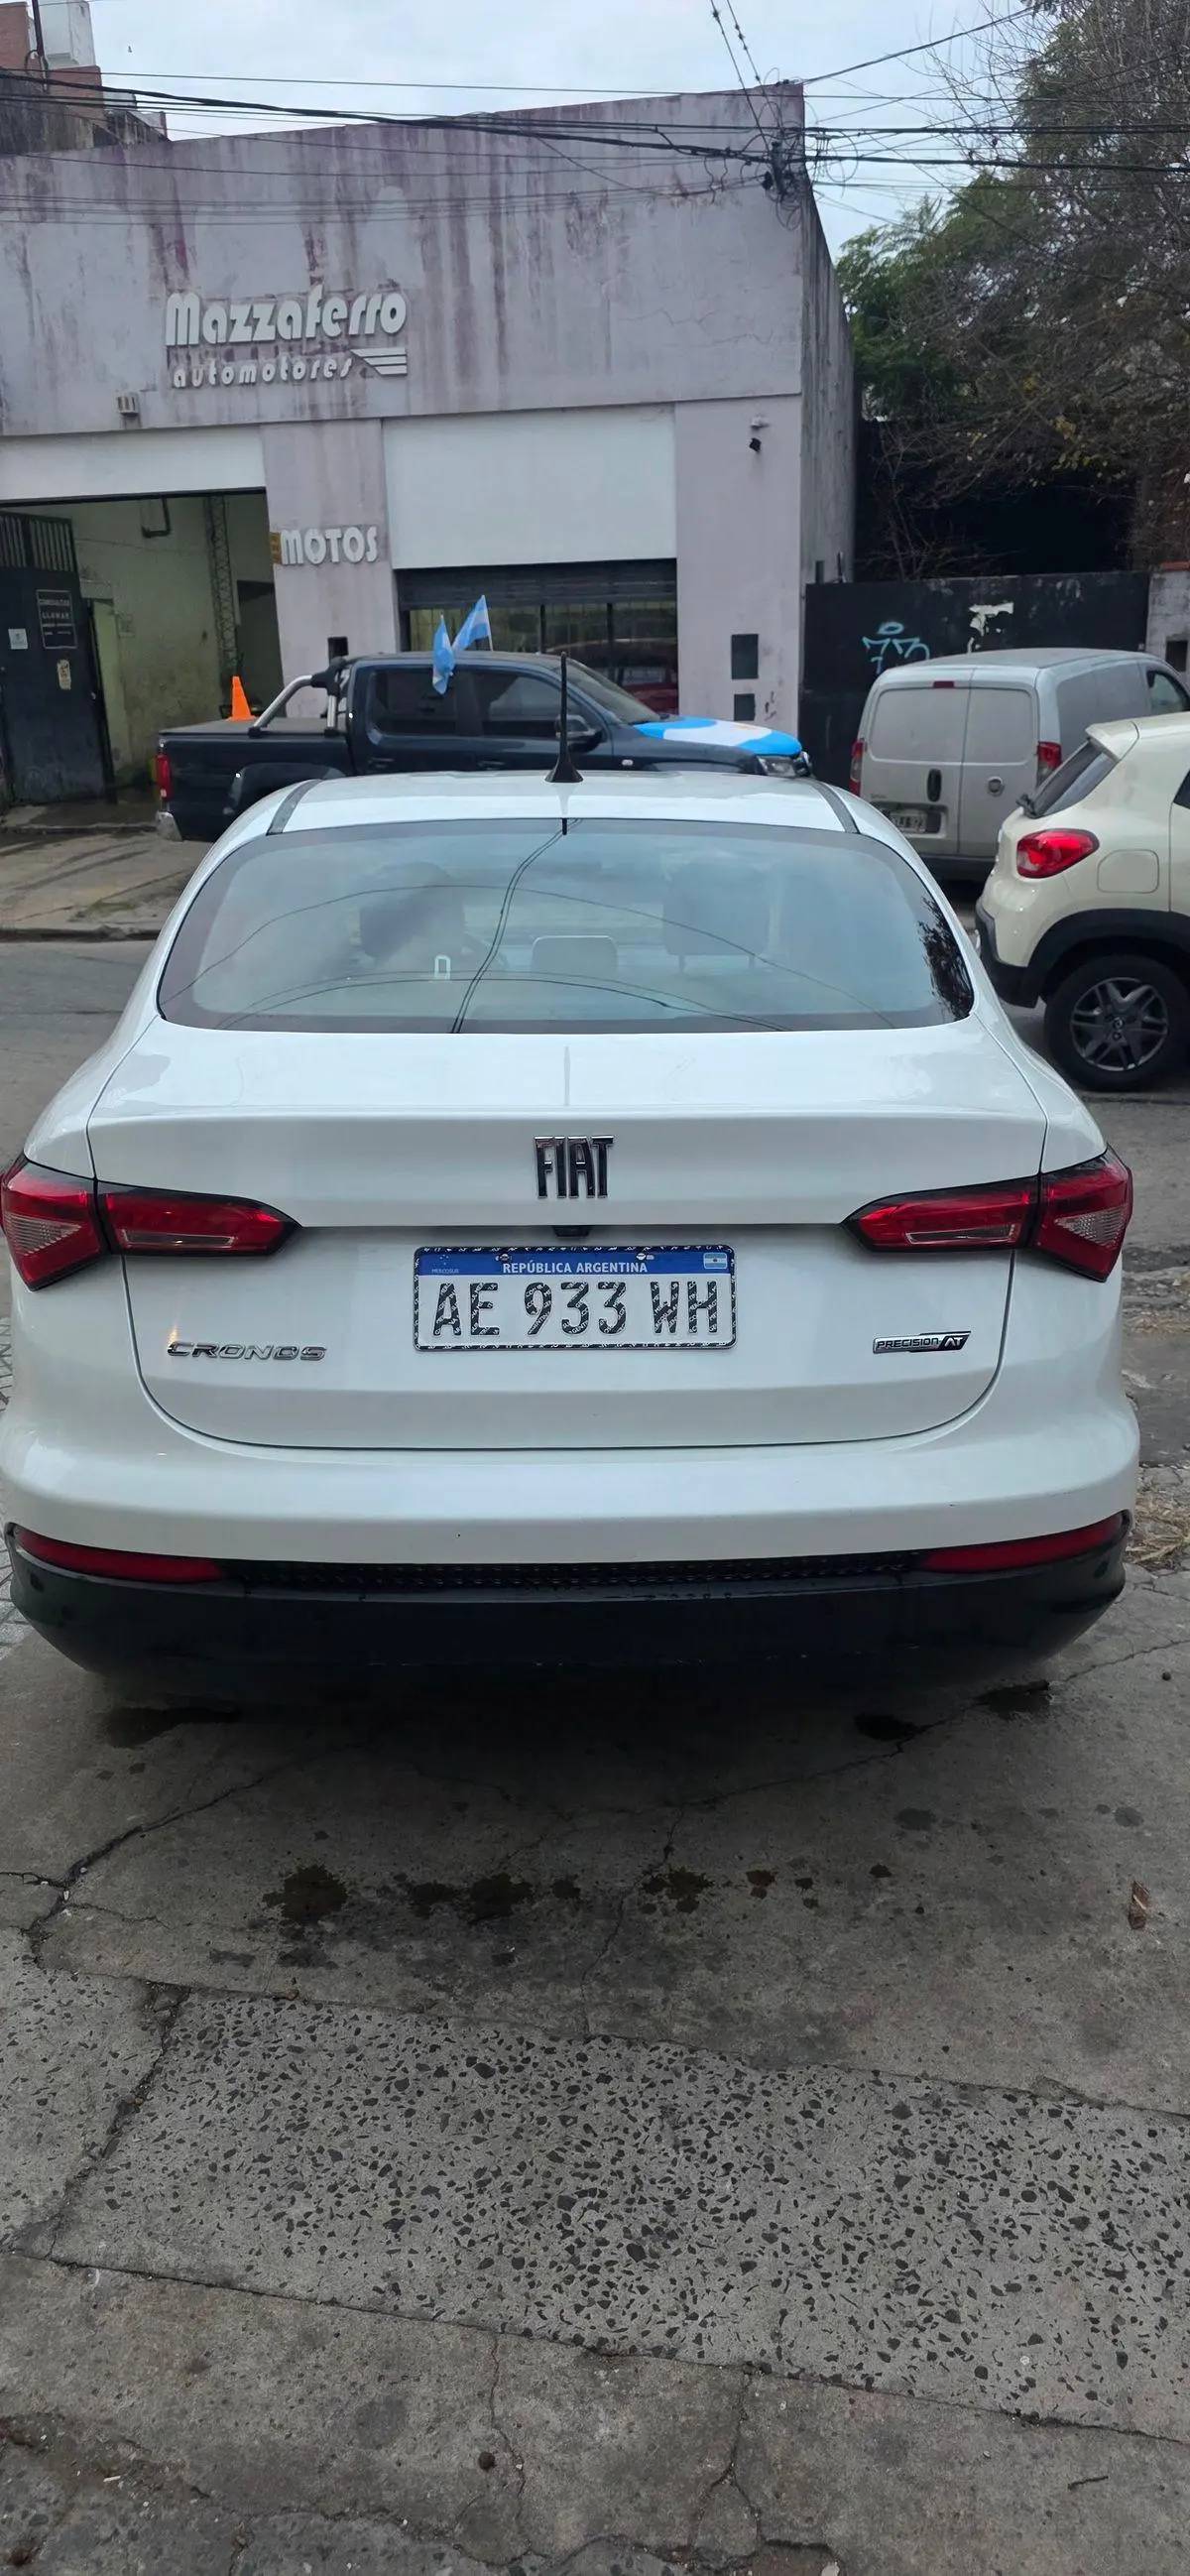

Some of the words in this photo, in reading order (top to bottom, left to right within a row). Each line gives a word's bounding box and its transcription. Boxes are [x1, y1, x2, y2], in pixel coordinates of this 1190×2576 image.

[166, 284, 408, 348] Mazzaferro
[173, 355, 353, 388] automotores
[280, 526, 378, 566] MOTOS
[535, 1135, 615, 1199] FIAT
[502, 1260, 572, 1275] REPÚBLICA
[576, 1261, 649, 1274] ARGENTINA
[432, 1283, 501, 1336] AE
[524, 1281, 627, 1336] 933
[650, 1280, 718, 1334] WH
[167, 1341, 327, 1362] CRONOS
[877, 1337, 940, 1350] PRECISION
[944, 1336, 964, 1348] AT
